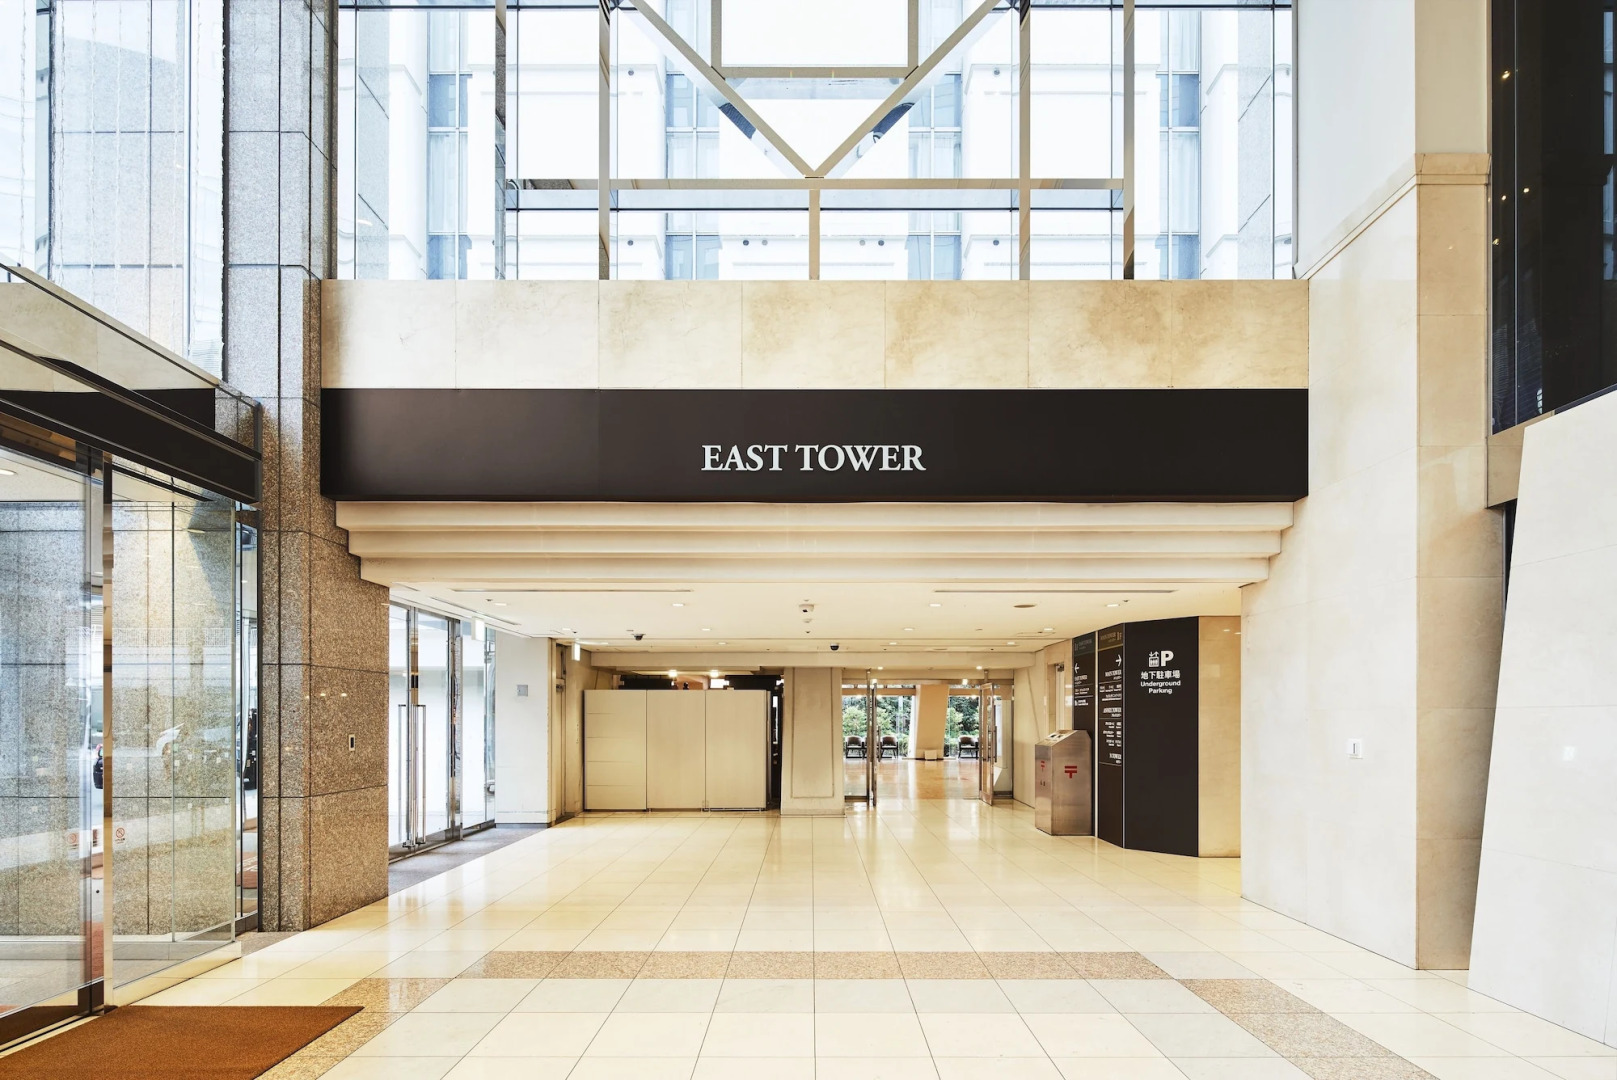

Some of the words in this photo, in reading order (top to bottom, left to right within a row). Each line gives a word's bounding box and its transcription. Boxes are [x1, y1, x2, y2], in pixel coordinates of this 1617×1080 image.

[701, 444, 788, 471] EAST
[795, 444, 926, 471] TOWER
[1160, 650, 1174, 667] P
